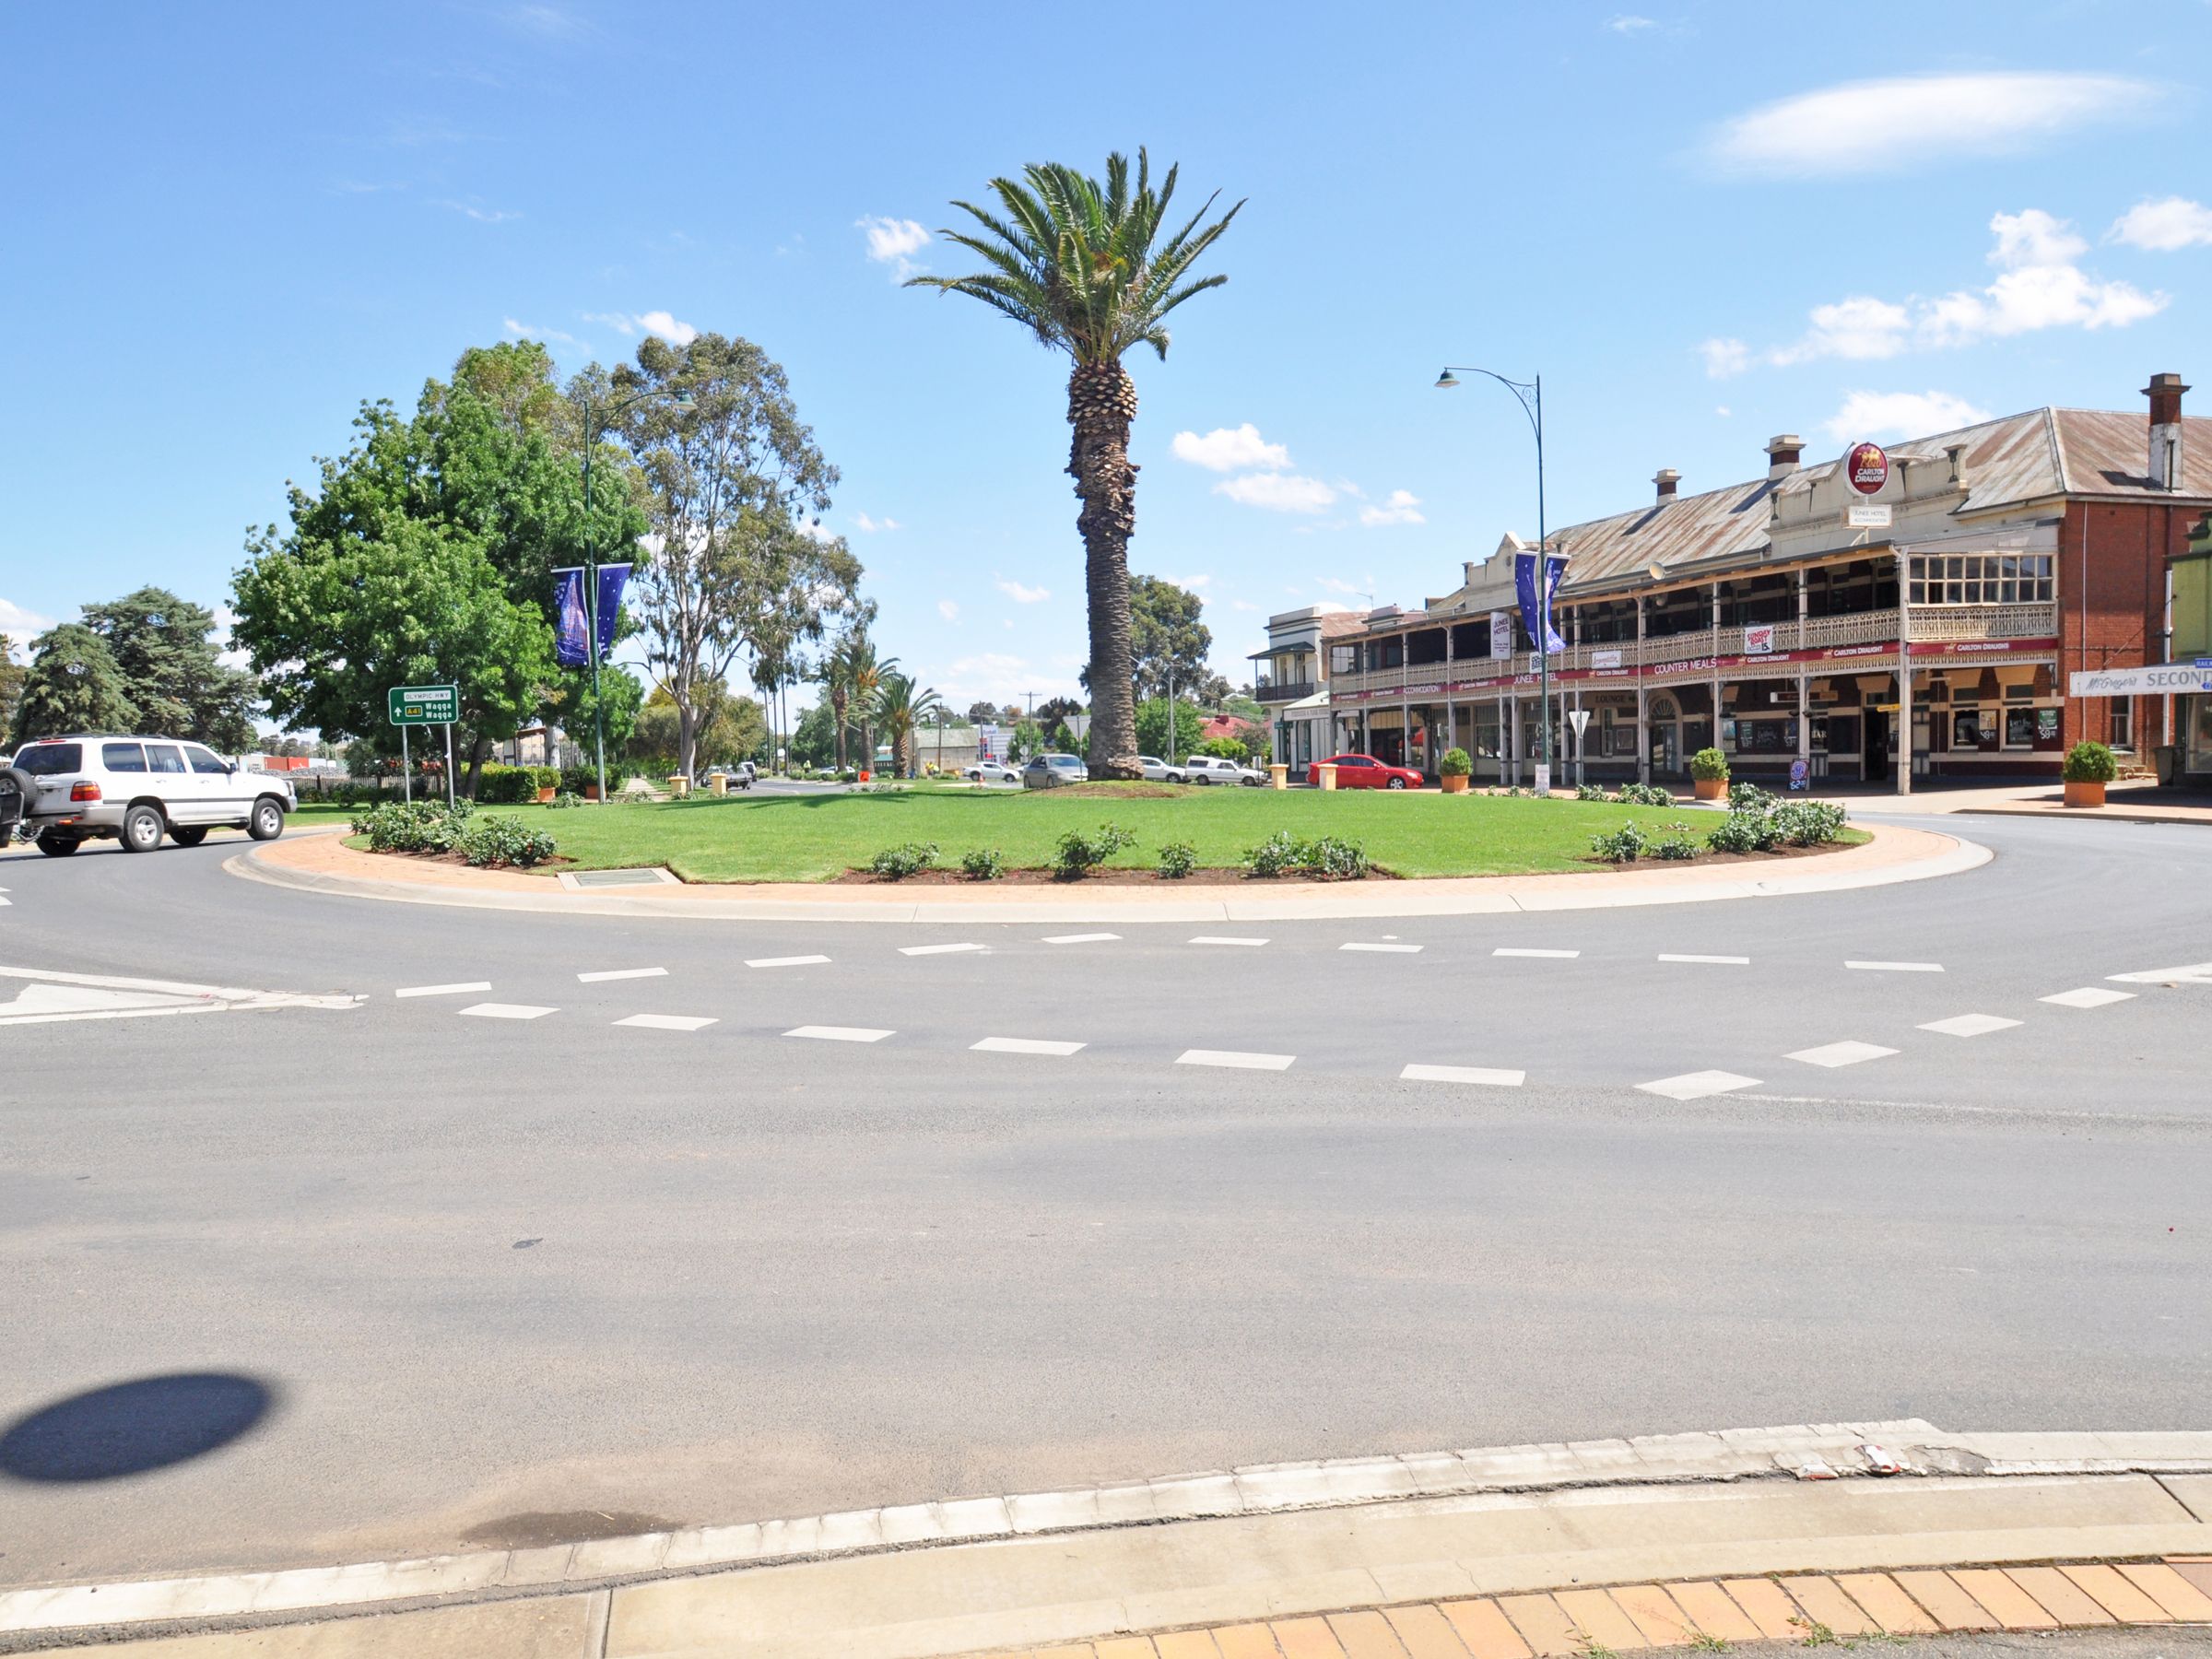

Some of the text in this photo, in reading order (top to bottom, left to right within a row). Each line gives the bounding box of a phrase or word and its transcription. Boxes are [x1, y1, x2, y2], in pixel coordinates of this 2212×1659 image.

[1855, 475, 1885, 483] DRAUGHT
[1494, 627, 1509, 636] HOTEL
[1747, 629, 1771, 641] SUNDAY
[1834, 645, 1883, 656] CARLTON DRAUGHT
[1654, 657, 1717, 675] COUNTER MEALS
[1513, 673, 1558, 684] JUNEE HTEL
[1595, 693, 1624, 703] LOUNGE
[425, 702, 452, 712] Wagga
[426, 712, 453, 720] Wagga
